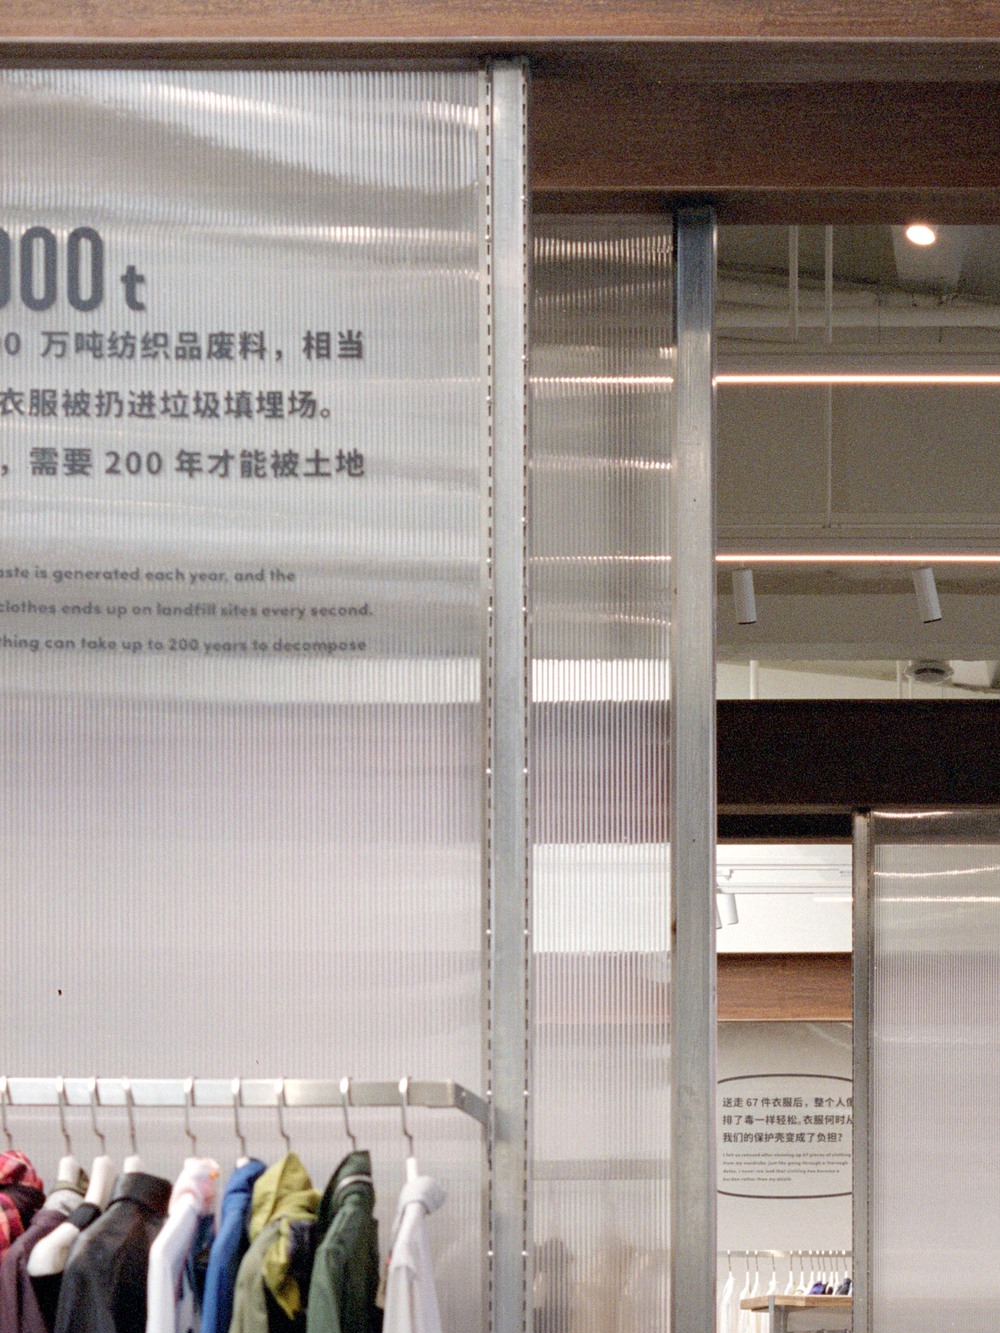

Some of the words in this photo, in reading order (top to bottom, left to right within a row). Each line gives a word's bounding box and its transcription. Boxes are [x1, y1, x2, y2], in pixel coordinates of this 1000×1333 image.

[0, 226, 104, 312] 00
[105, 451, 163, 475] 200
[175, 448, 365, 478] 年才能被土地
[35, 565, 48, 578] is
[53, 567, 140, 583] generated
[145, 568, 185, 581] each
[234, 569, 264, 581] and
[270, 569, 296, 581] the
[61, 602, 100, 615] ends
[106, 605, 127, 619] up
[132, 605, 152, 616] on
[261, 606, 306, 619] every
[311, 603, 373, 616] second.
[45, 639, 75, 650] can
[81, 636, 117, 650] take
[122, 639, 142, 653] up
[148, 638, 164, 650] to
[169, 639, 198, 651] 200
[204, 641, 247, 654] years
[253, 639, 268, 651] to
[273, 638, 367, 654] decompose
[722, 1097, 743, 1108] 送走
[746, 1097, 758, 1107] 67
